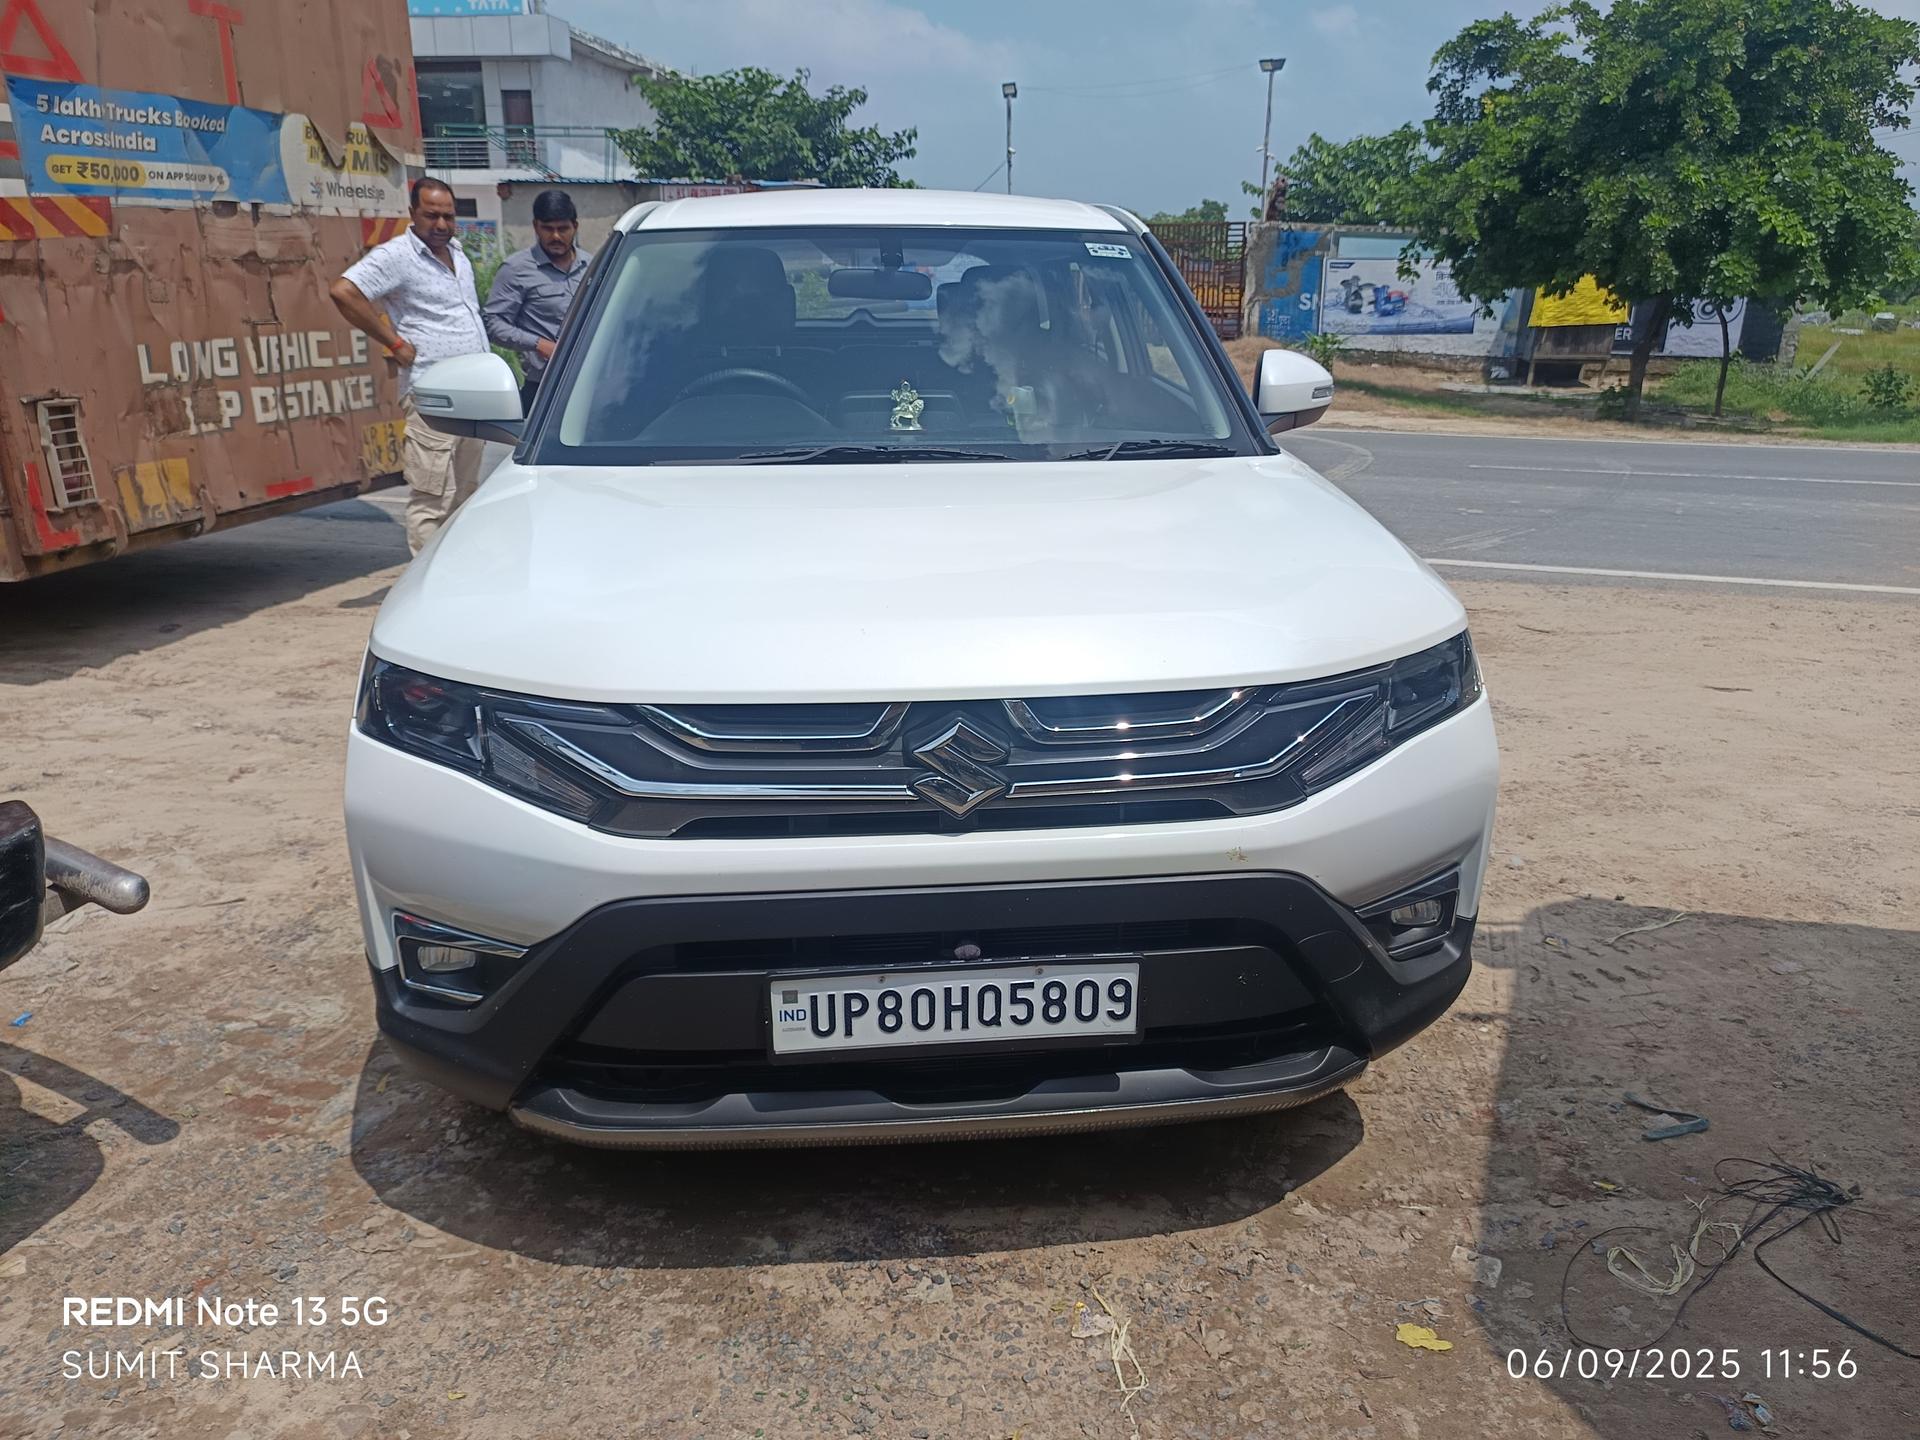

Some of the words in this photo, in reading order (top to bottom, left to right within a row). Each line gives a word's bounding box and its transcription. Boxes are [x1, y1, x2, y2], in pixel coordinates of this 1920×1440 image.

[36, 93, 49, 113] 5
[105, 102, 172, 125] Trucks
[175, 110, 226, 132] Booked
[51, 164, 73, 174] GET
[76, 161, 140, 183] ₹50,000
[148, 170, 164, 180] ON
[166, 171, 183, 181] APP
[136, 337, 240, 384] LONG
[250, 374, 374, 424] DISTANCE
[779, 1009, 807, 1022] IND
[809, 976, 1133, 1038] UP80HQ5809
